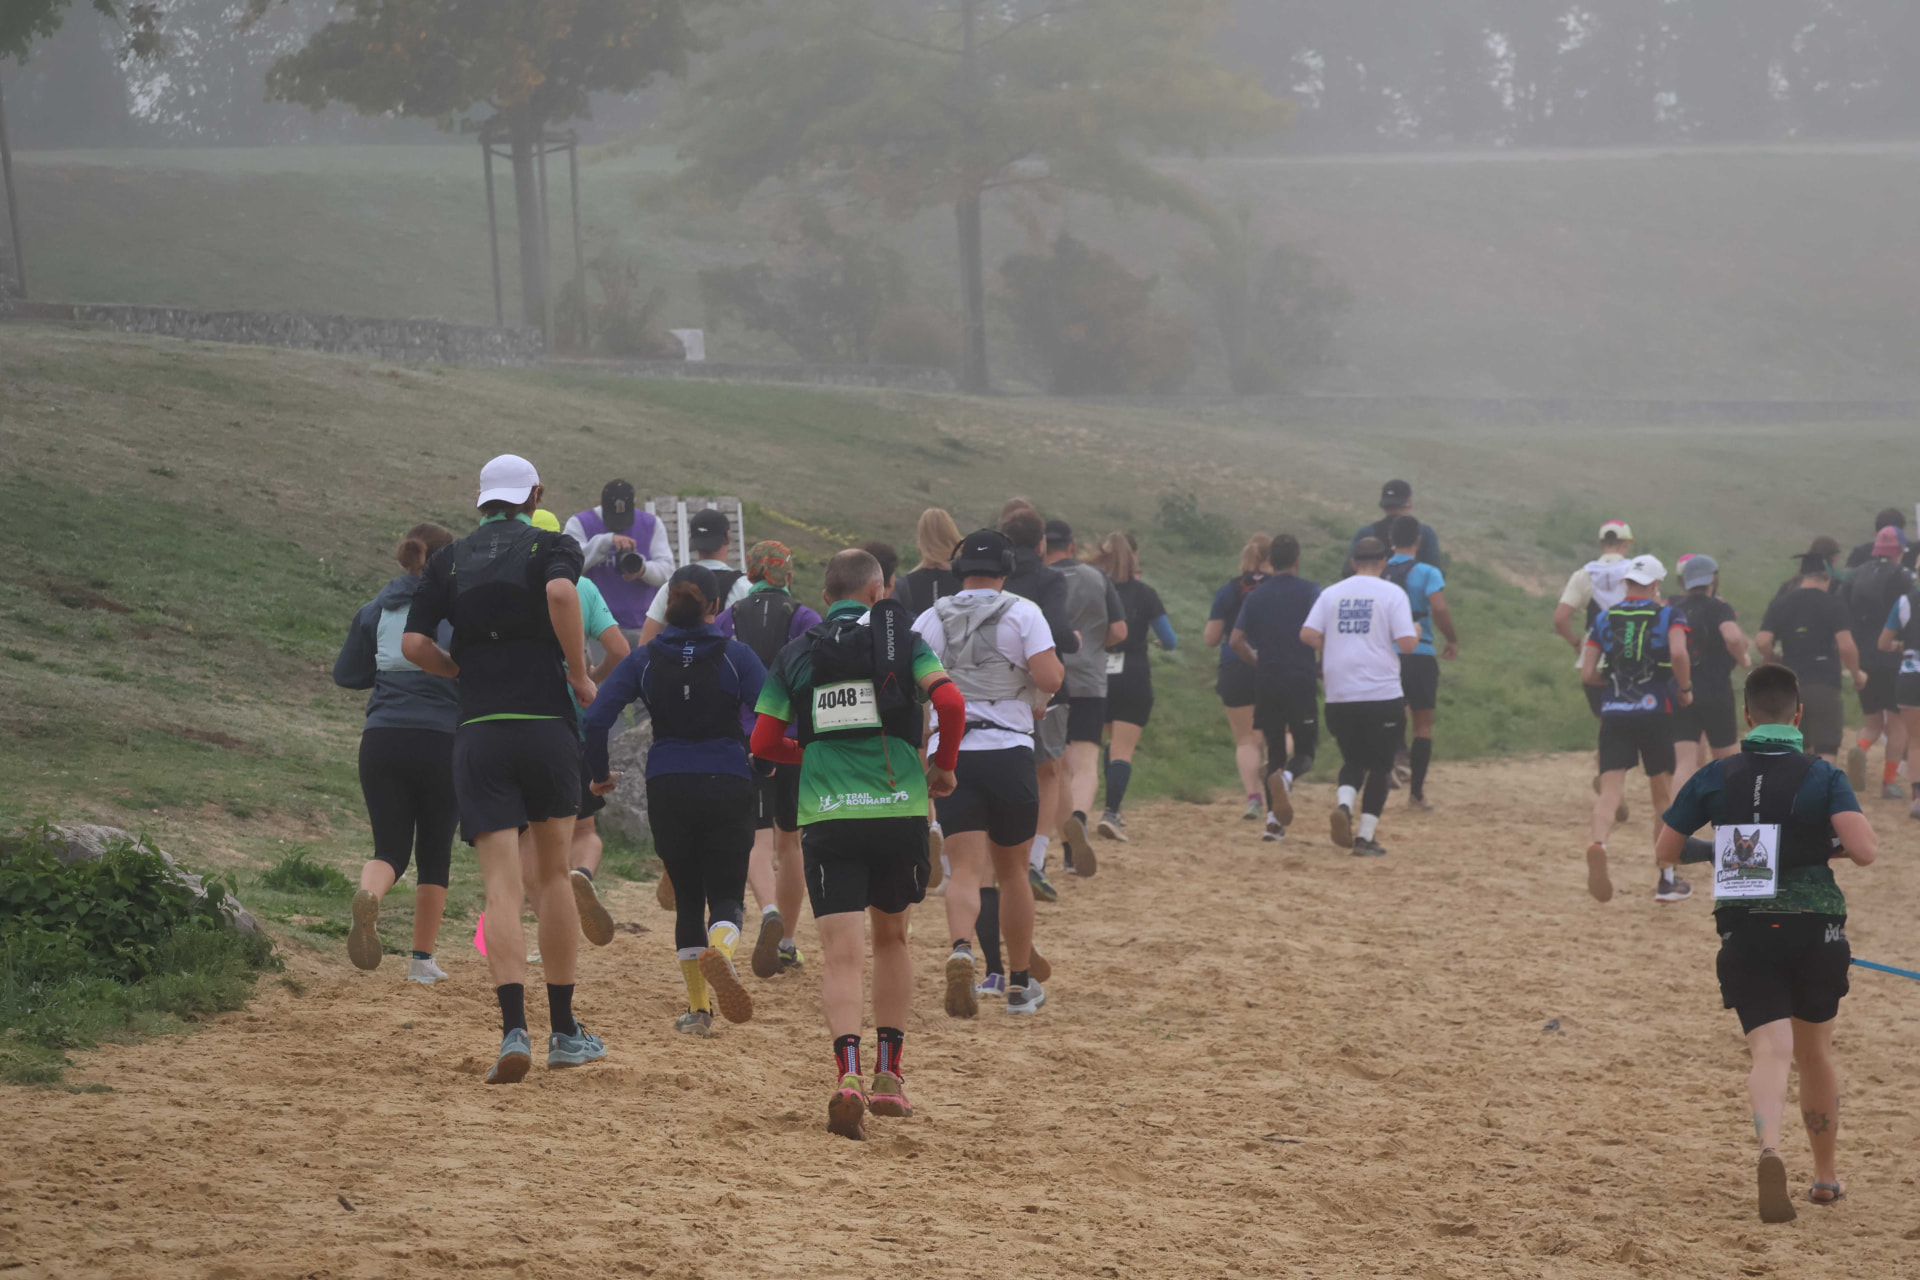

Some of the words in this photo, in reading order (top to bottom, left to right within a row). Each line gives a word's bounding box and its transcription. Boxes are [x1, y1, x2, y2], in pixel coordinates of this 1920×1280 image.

[885, 609, 895, 661] SALOMON
[1337, 620, 1371, 635] CLUB
[818, 687, 857, 710] 4048
[845, 792, 873, 800] TRAIL
[845, 796, 892, 806] ROUMARE
[891, 790, 909, 804] 76
